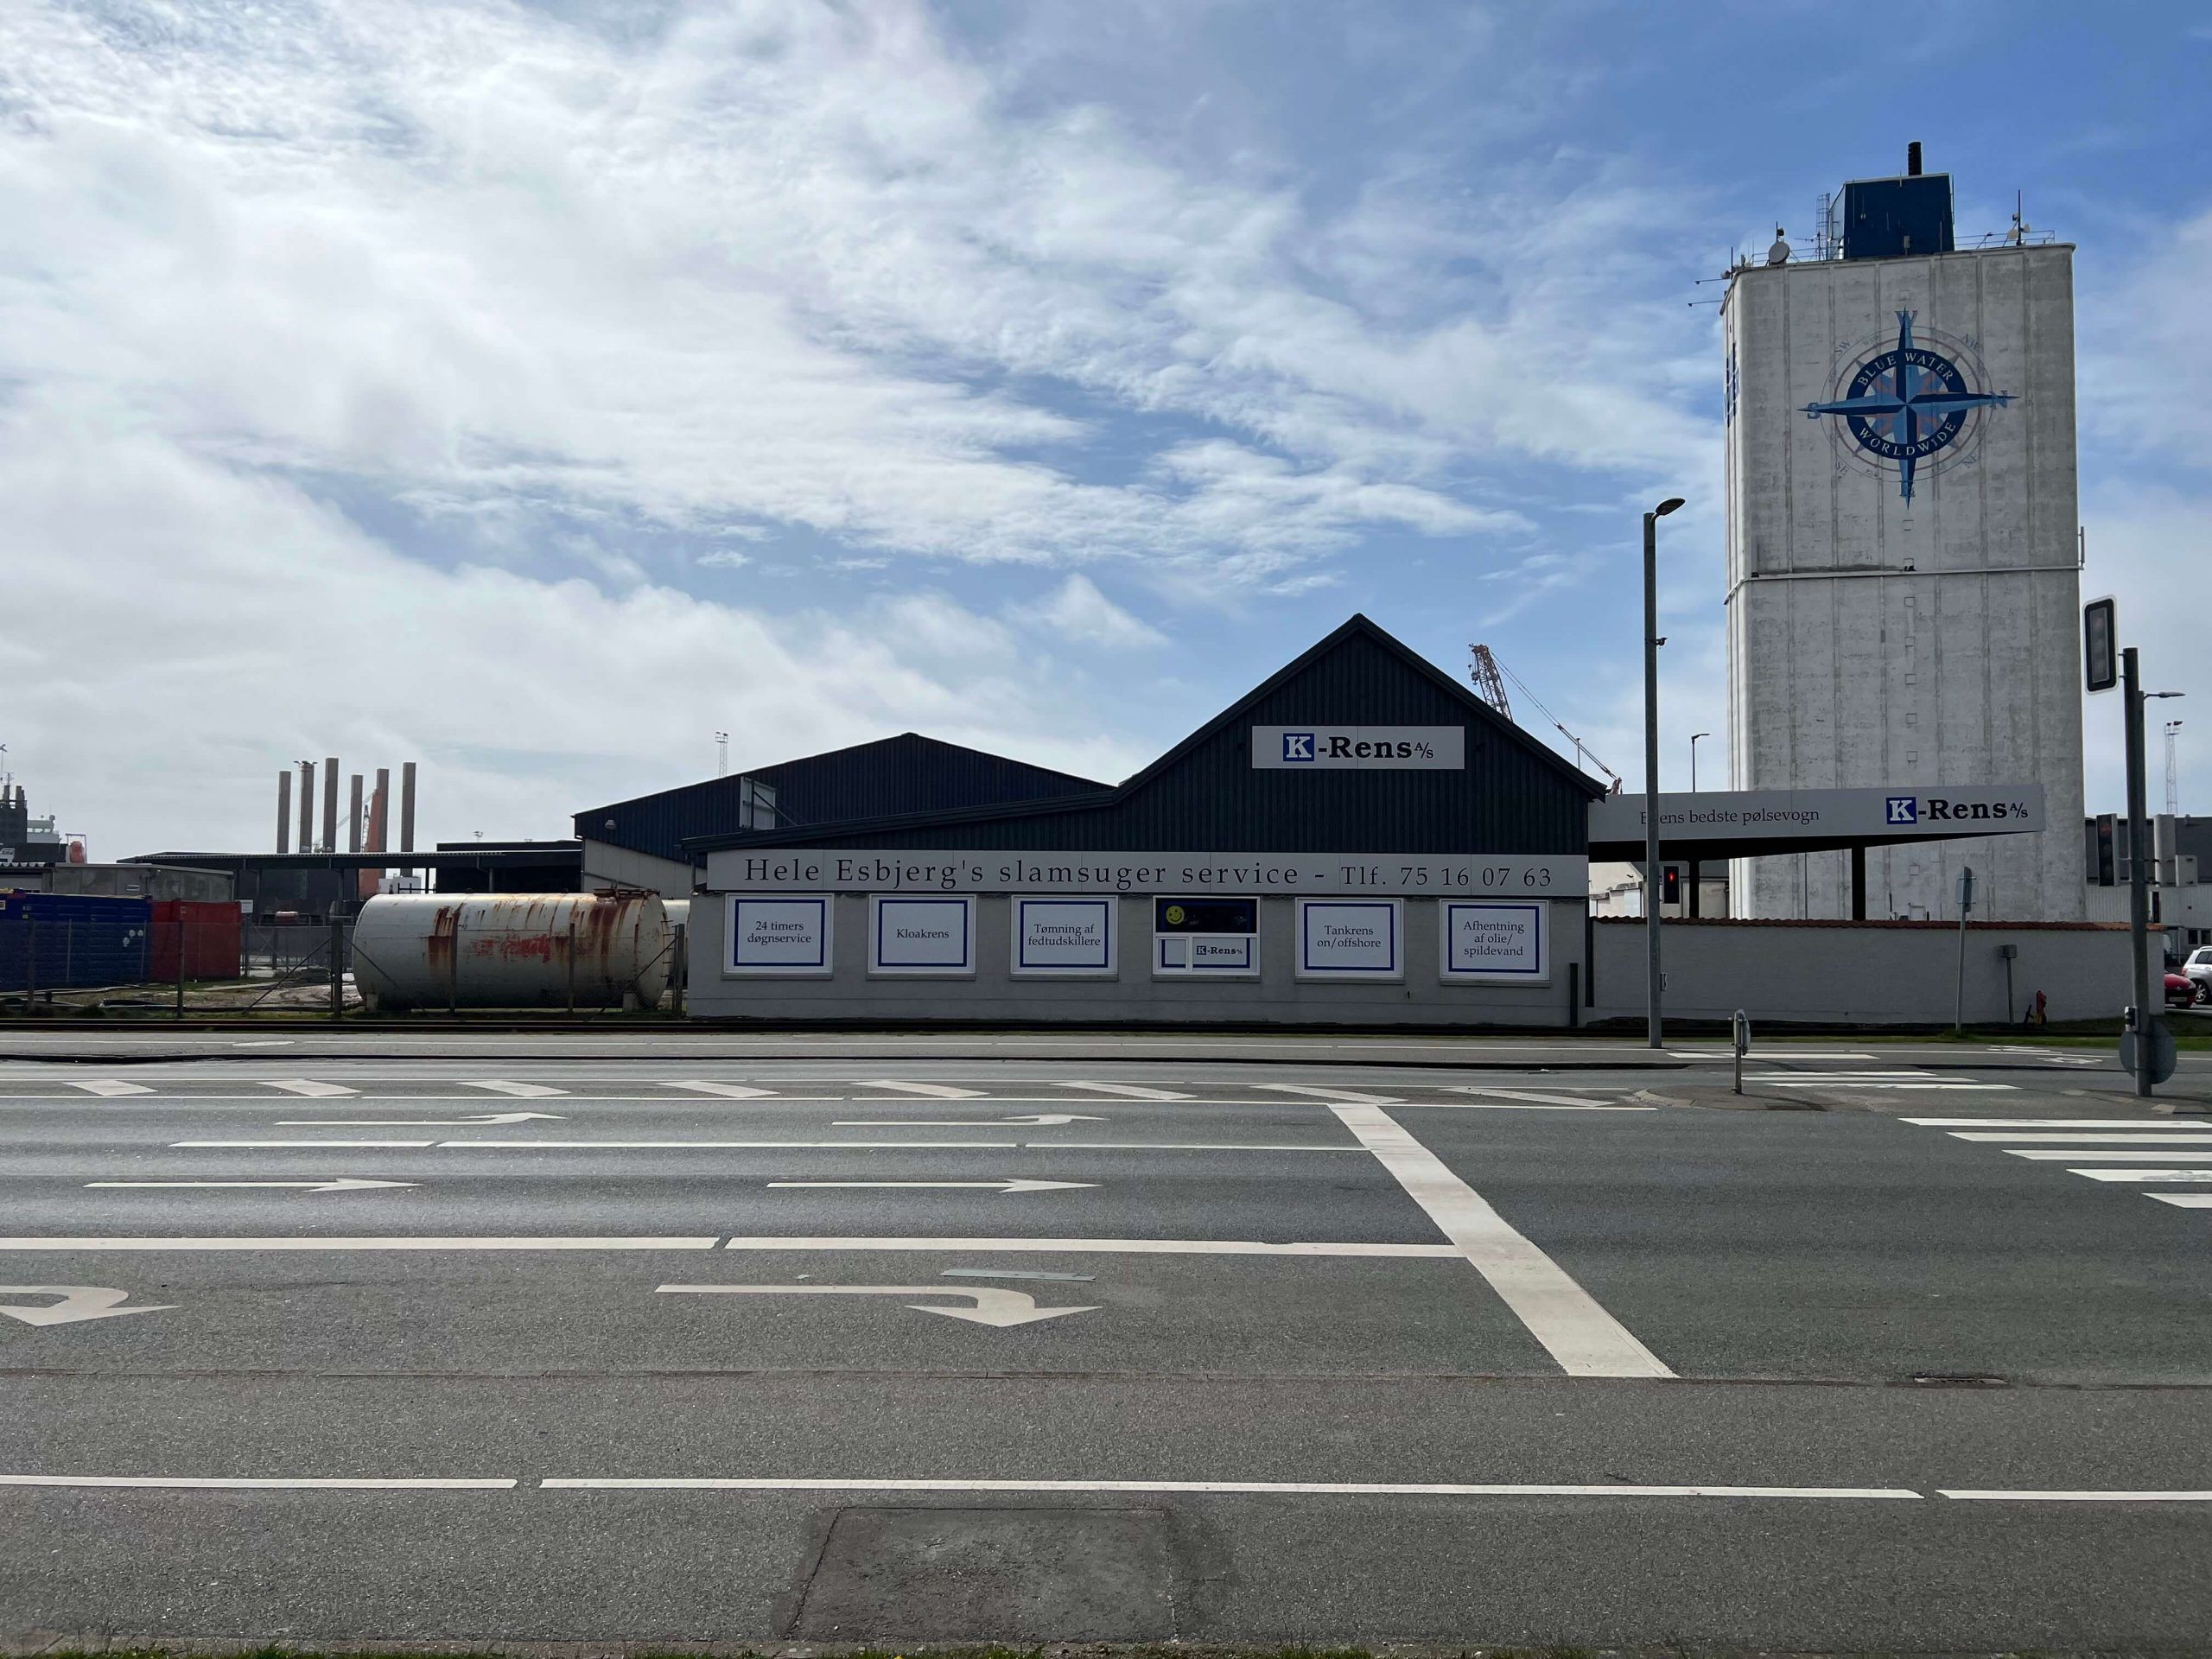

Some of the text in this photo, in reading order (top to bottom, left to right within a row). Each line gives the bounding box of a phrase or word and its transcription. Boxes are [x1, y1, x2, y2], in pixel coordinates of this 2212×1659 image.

[1858, 353, 1954, 385] BLUE WATER
[1859, 422, 1956, 456] WORLDWIDE
[1689, 809, 1738, 823] bedste
[1742, 808, 1820, 826] pølsevogn
[744, 858, 820, 881] Hele
[836, 859, 984, 890] Esbjerg's
[999, 860, 1166, 892] slamsuger
[1181, 862, 1299, 885] service
[1340, 865, 1387, 887] Tlf.
[1400, 867, 1428, 887] 75
[1441, 867, 1470, 887] 16
[1482, 868, 1511, 887] 07
[1523, 868, 1552, 887] 63
[755, 920, 804, 931] 24 timers
[1033, 923, 1096, 938] Tømning af
[1324, 924, 1374, 936] Tankrens
[1463, 919, 1525, 935] Afhentning
[747, 932, 812, 946] døgnservice
[896, 927, 950, 940] Kloakrens
[1474, 932, 1513, 945] af olie/
[1028, 935, 1102, 947] fedtudskillere
[1317, 937, 1382, 950] on/offshore
[1464, 944, 1524, 957] spildevand
